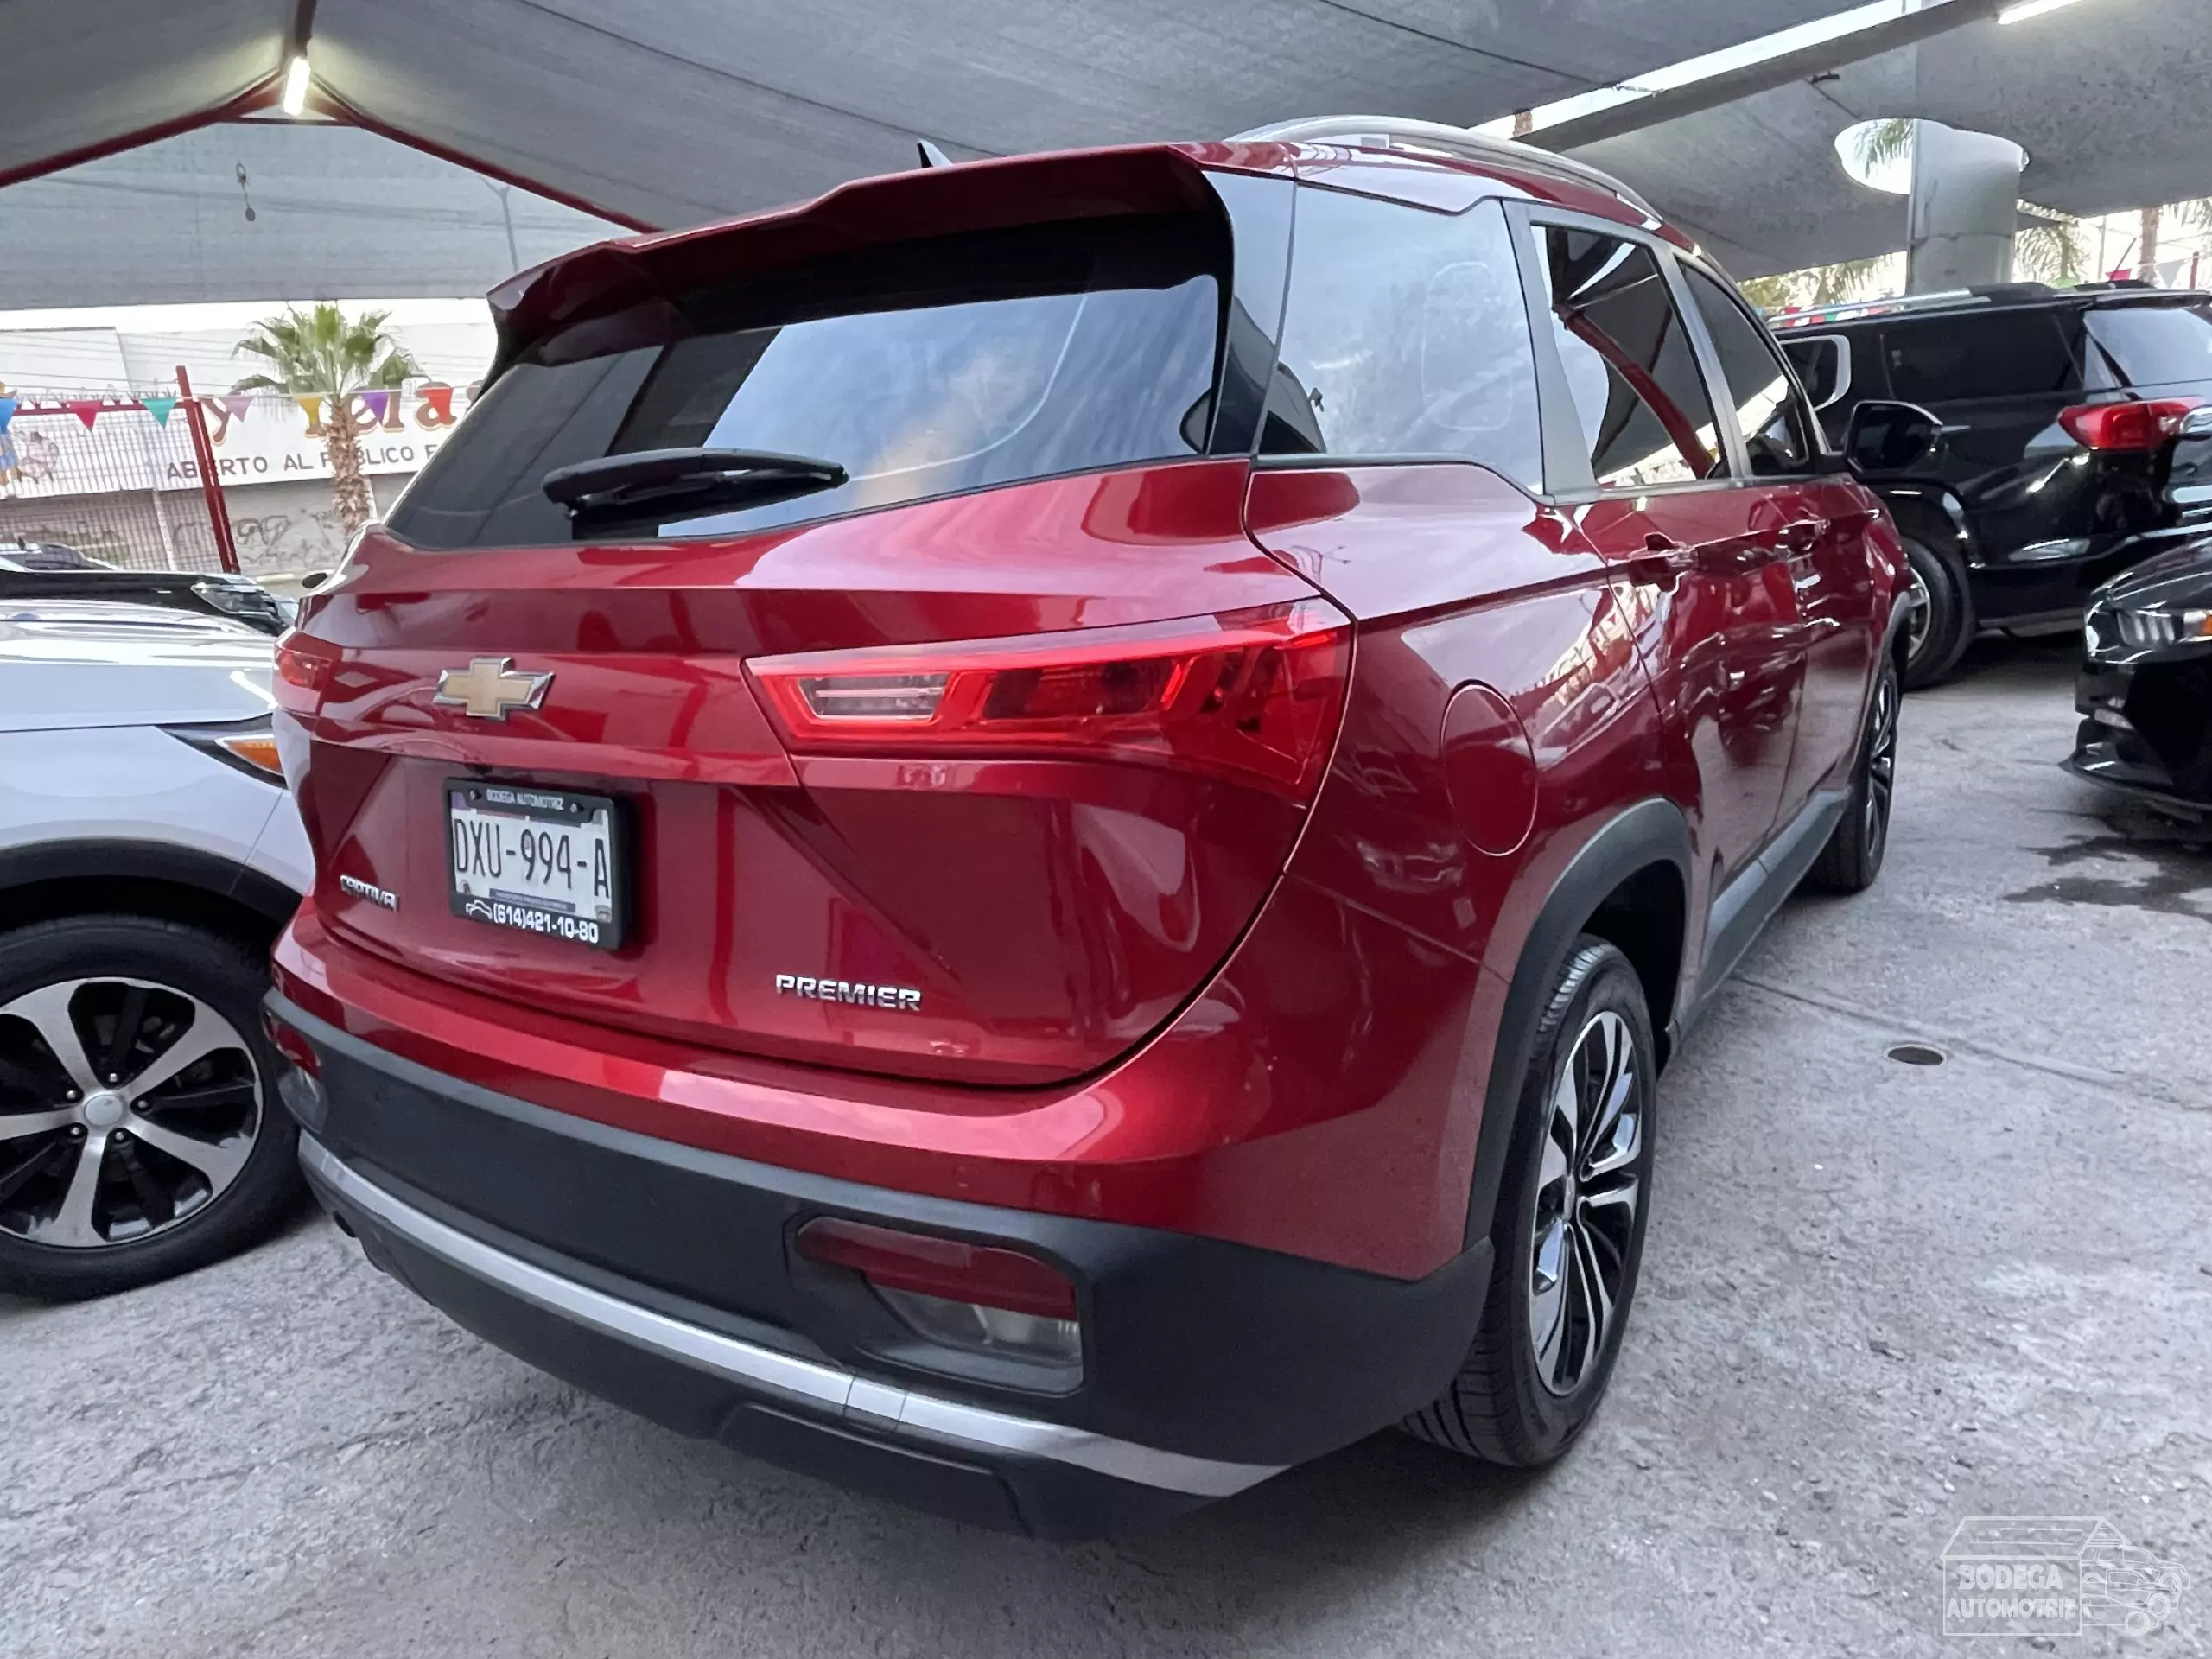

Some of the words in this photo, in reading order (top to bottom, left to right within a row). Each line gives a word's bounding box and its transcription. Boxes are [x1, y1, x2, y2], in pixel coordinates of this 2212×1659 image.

[167, 456, 268, 480] ABRTO
[283, 453, 314, 471] AL
[486, 788, 516, 804] BODEGA
[454, 818, 610, 899] DXU-994-A
[340, 874, 398, 912] CAPTIVA
[776, 974, 922, 1012] PREMIER
